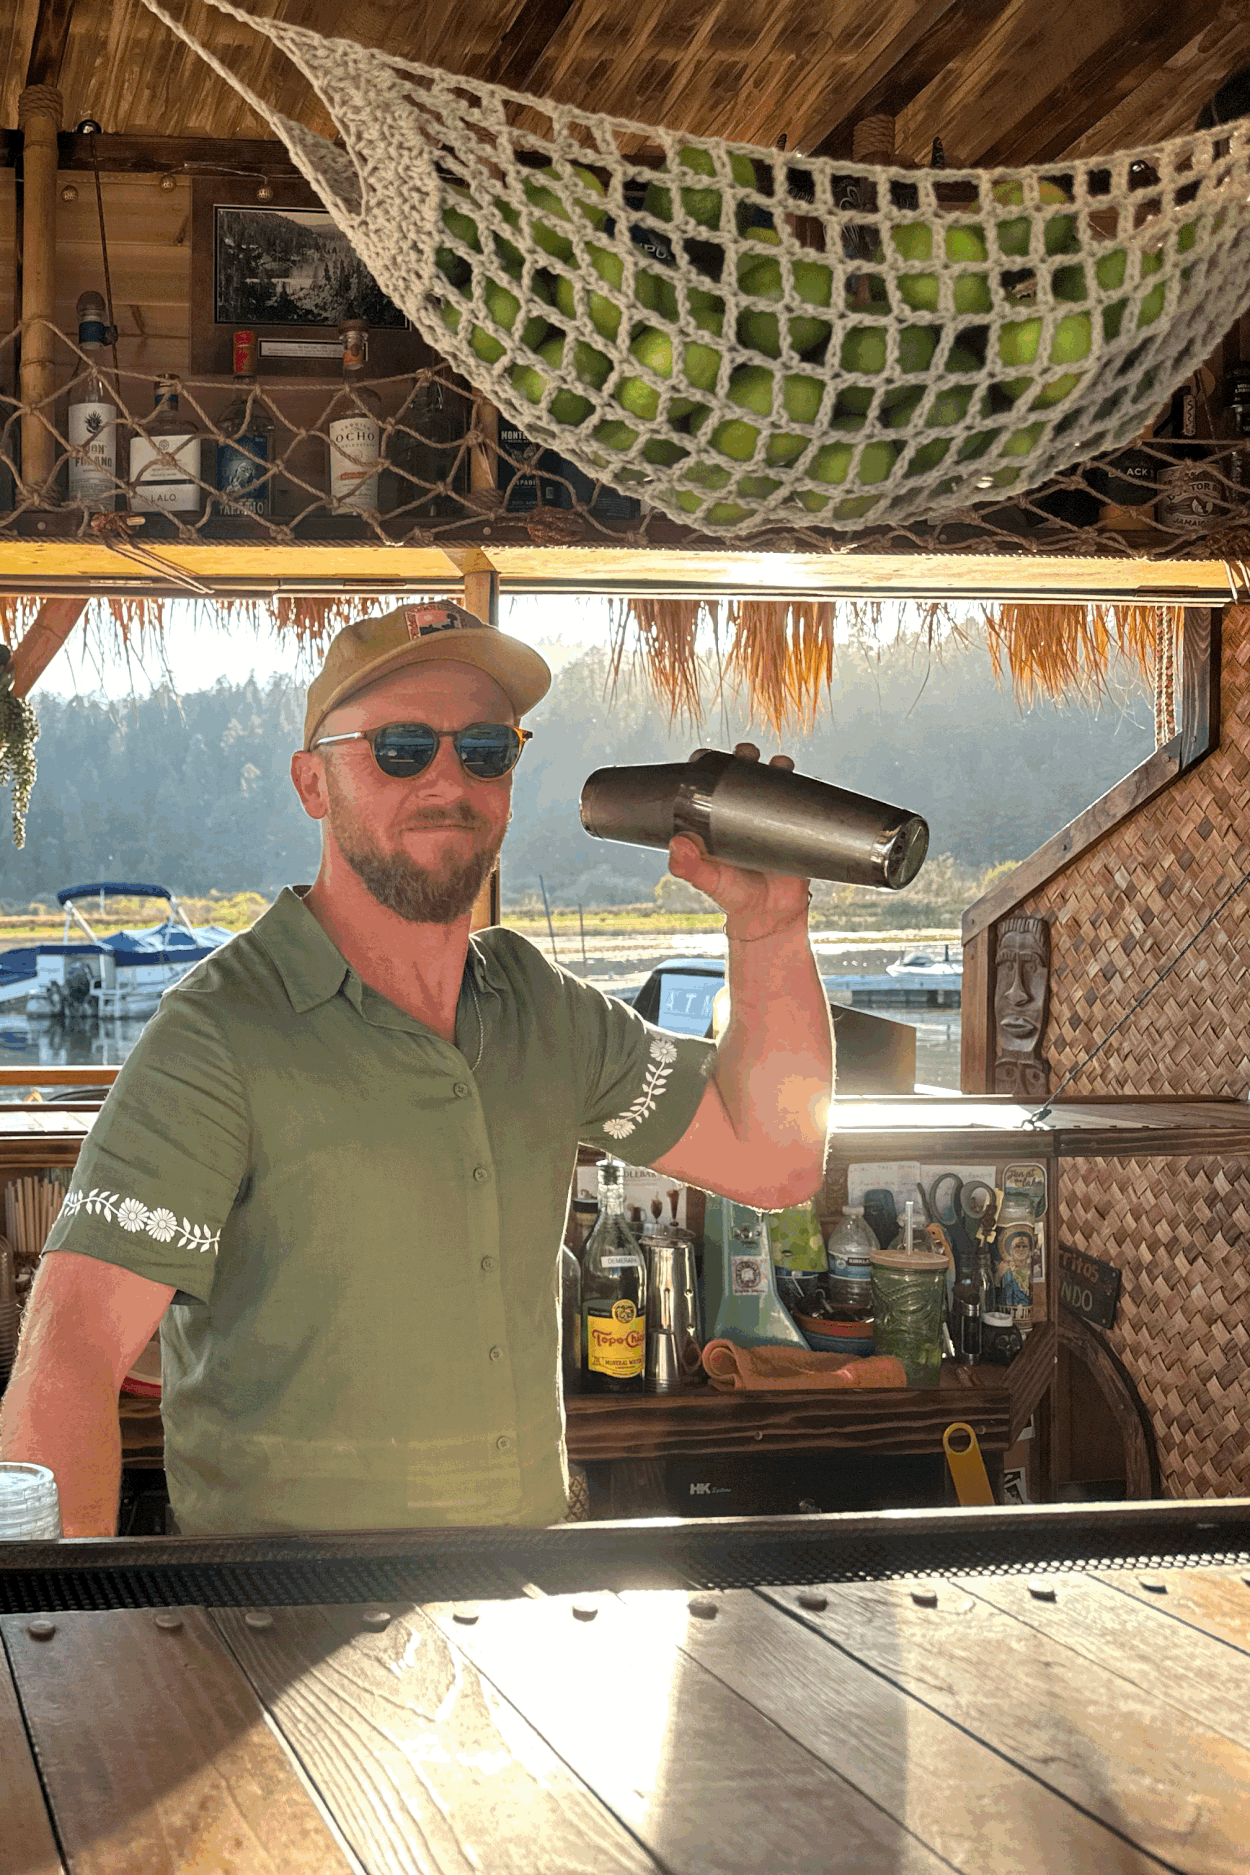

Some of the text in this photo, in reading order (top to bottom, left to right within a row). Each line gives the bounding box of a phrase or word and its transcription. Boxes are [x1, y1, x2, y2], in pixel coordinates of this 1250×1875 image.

[336, 432, 375, 443] OCHO
[592, 1329, 624, 1346] Topo
[690, 1482, 711, 1495] HK
